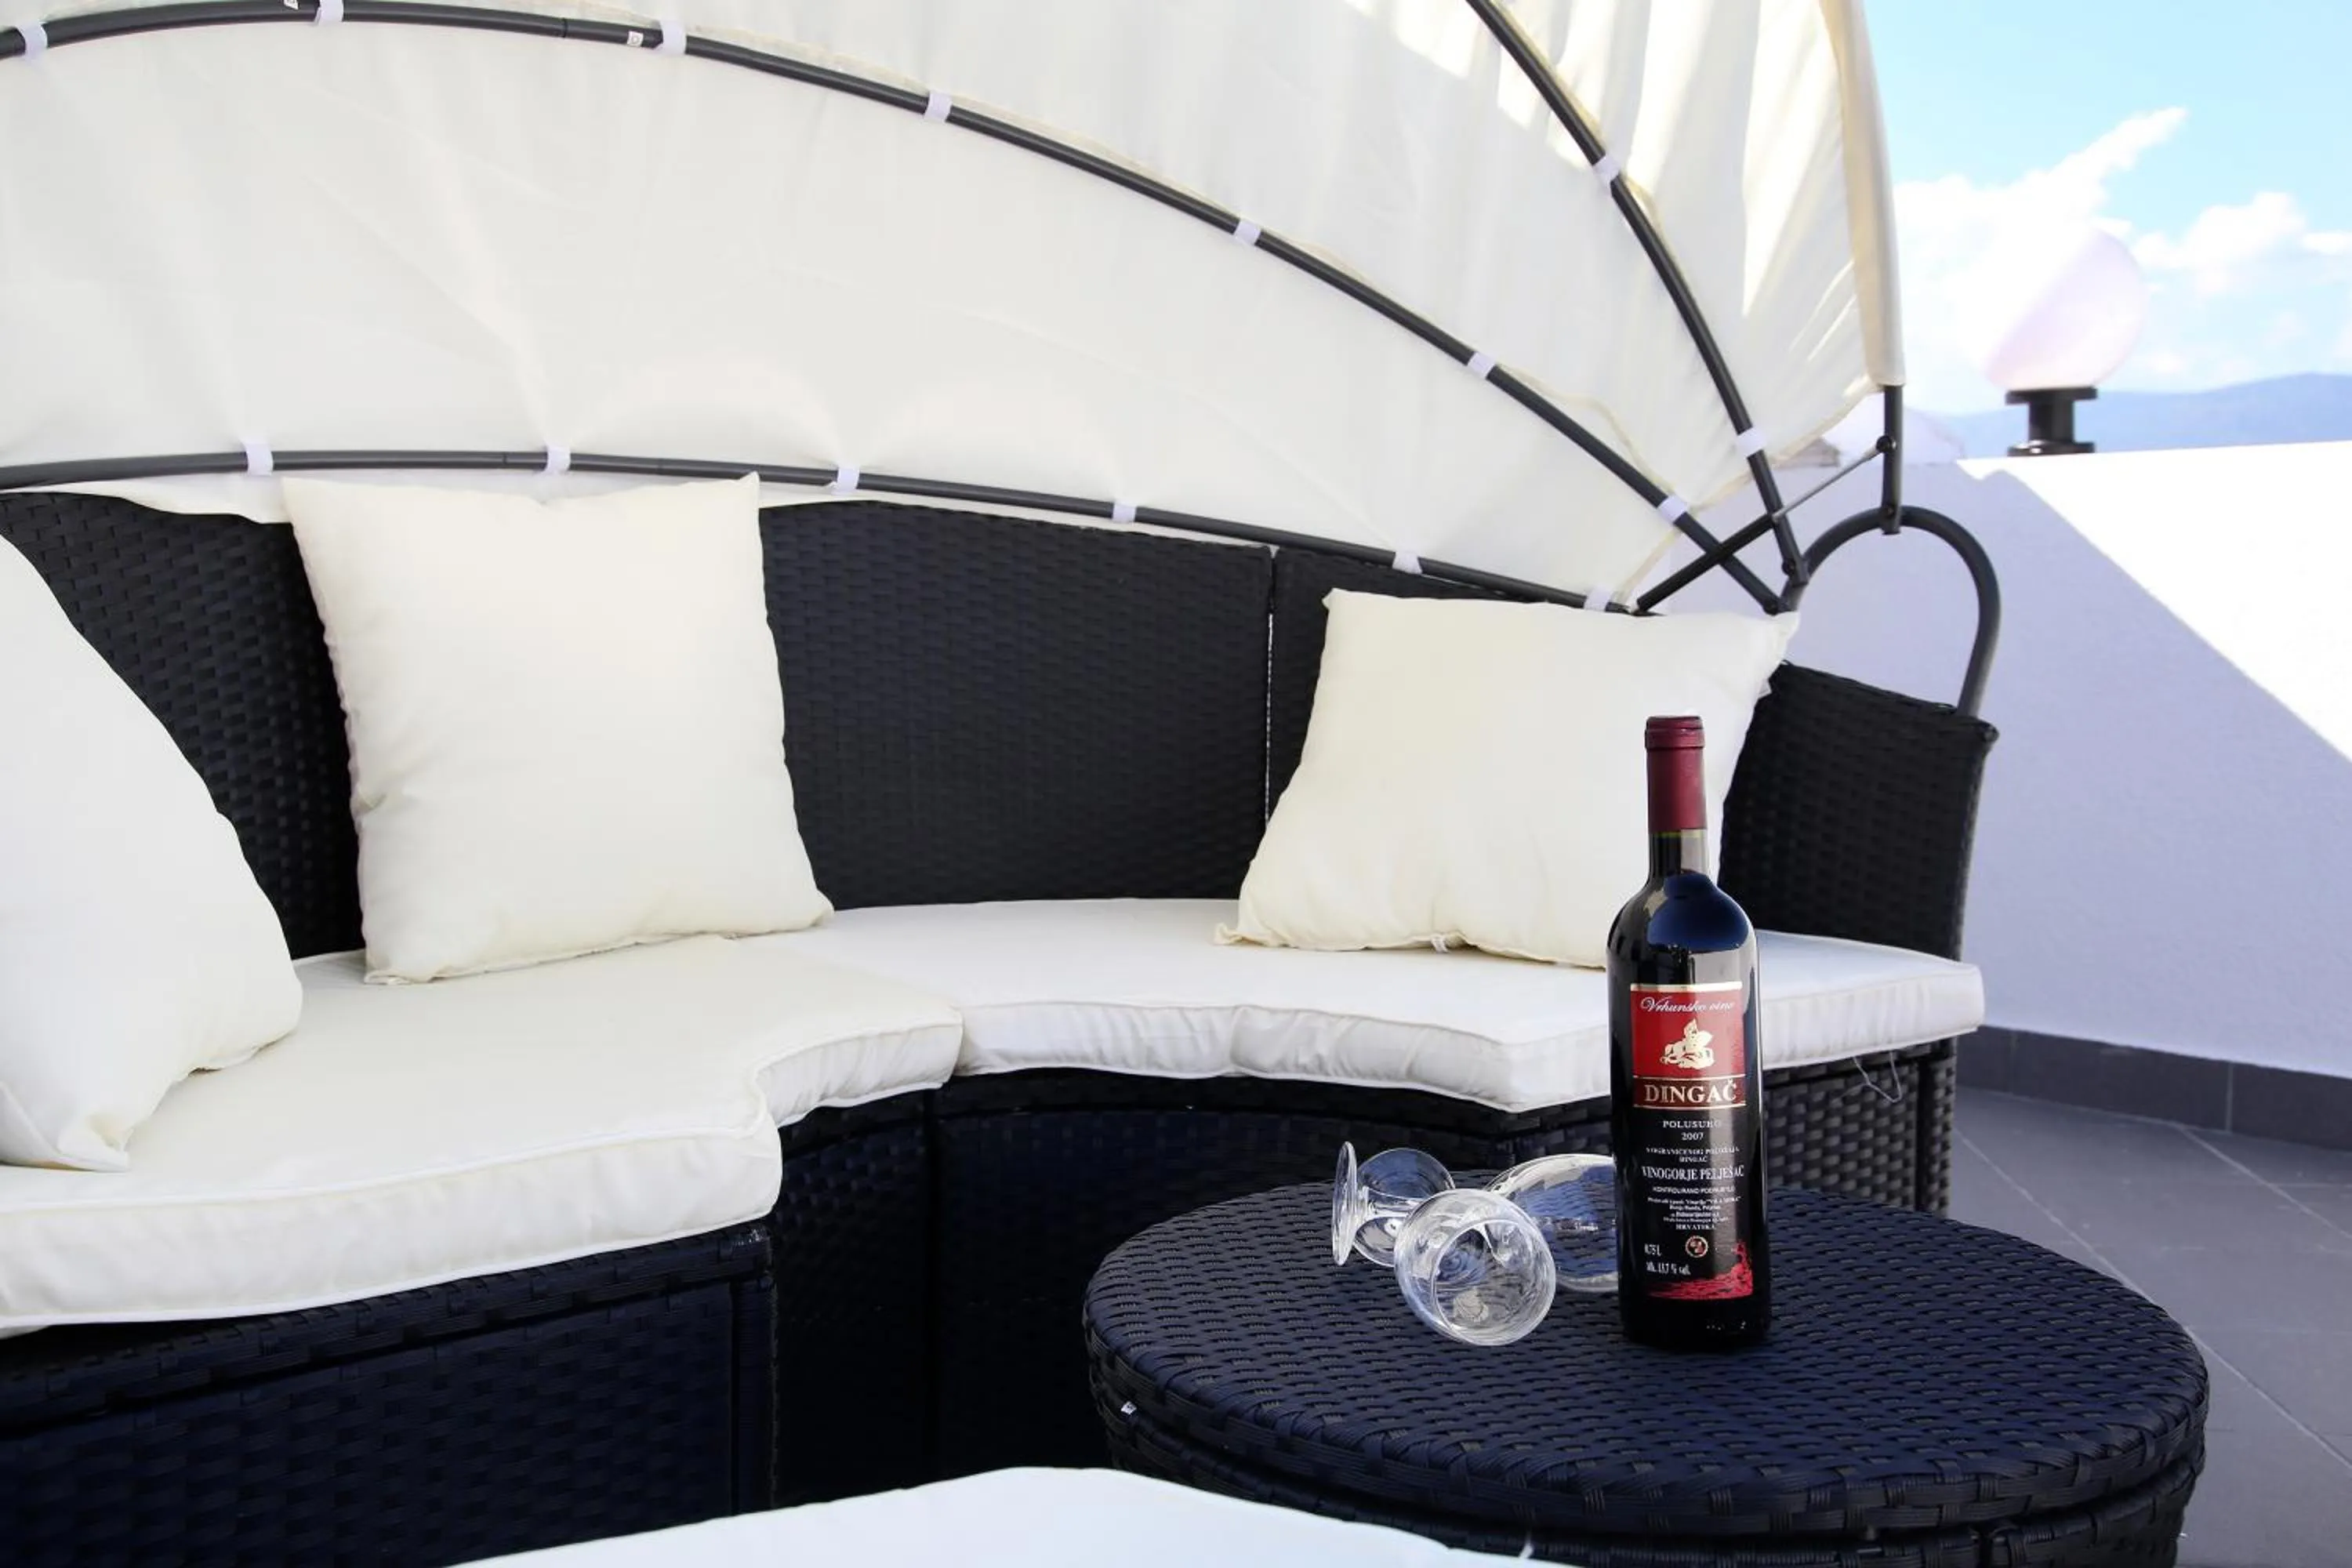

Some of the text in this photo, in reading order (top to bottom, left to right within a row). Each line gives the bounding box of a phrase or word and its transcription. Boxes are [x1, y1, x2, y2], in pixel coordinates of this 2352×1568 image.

[1644, 1079, 1737, 1104] DINGAČ
[1681, 1131, 1704, 1141] 2007
[1641, 1165, 1698, 1181] VINOGORJE
